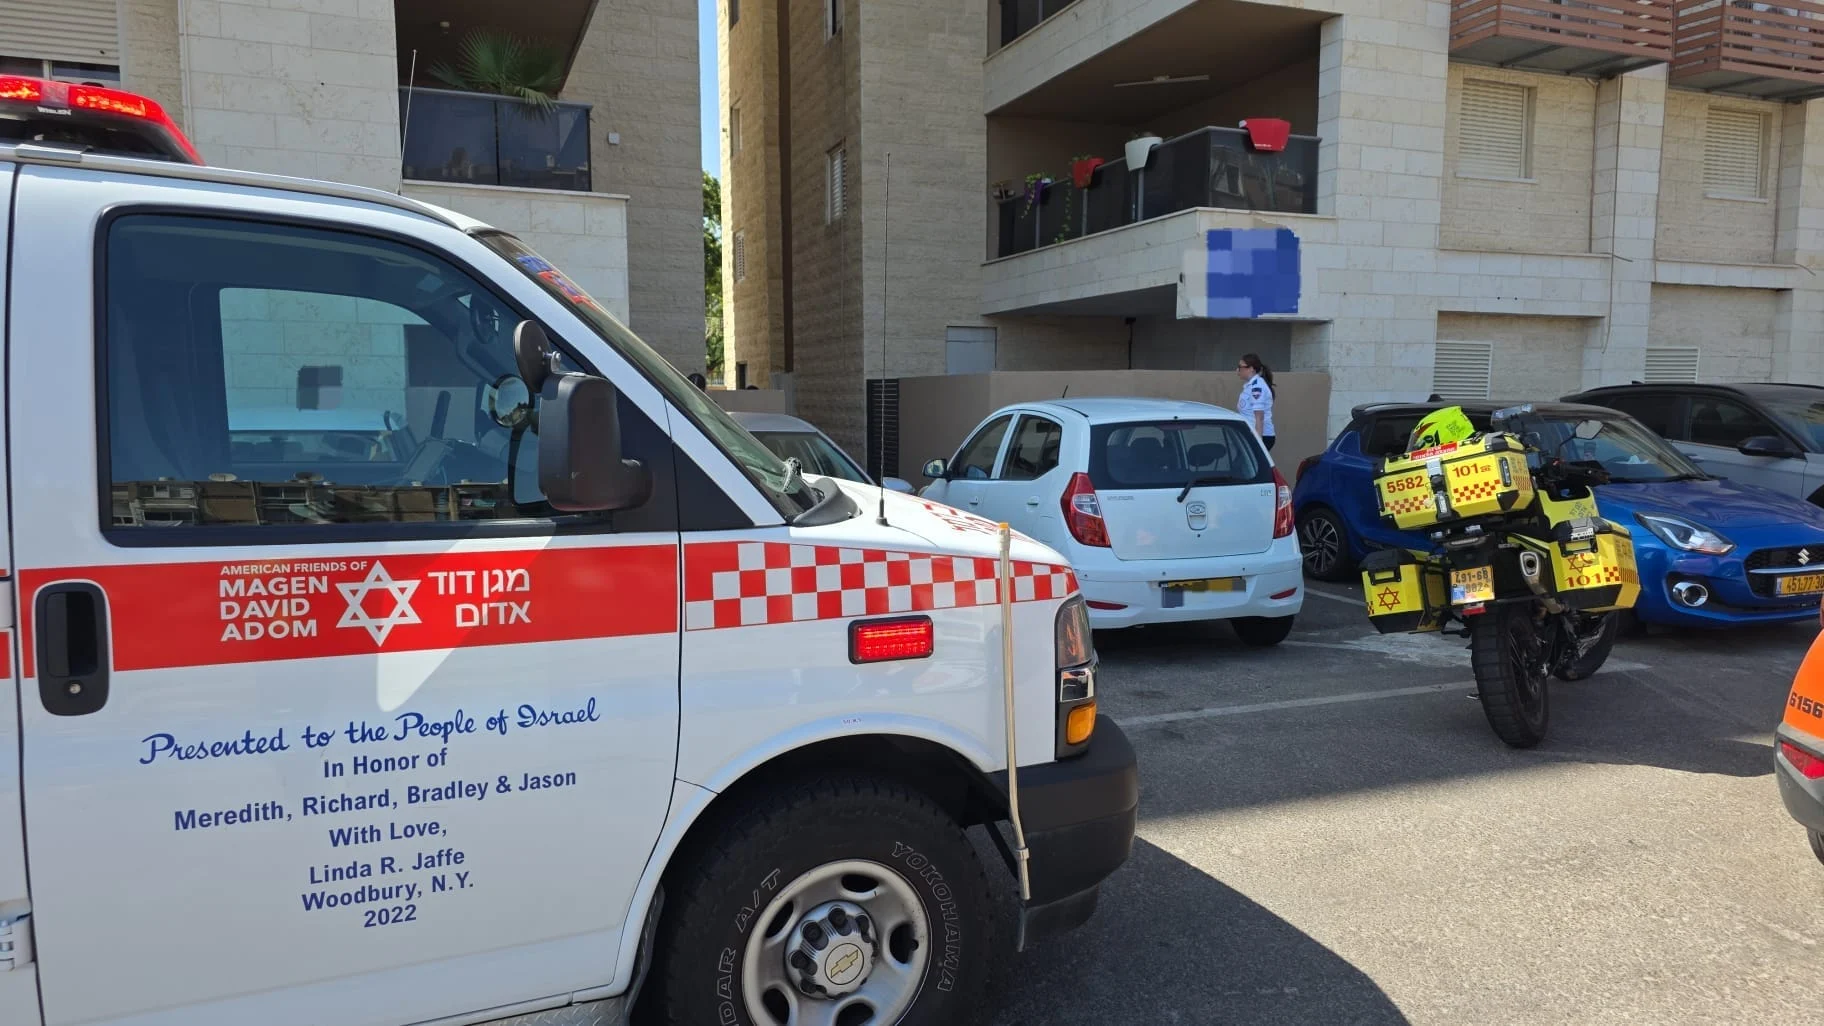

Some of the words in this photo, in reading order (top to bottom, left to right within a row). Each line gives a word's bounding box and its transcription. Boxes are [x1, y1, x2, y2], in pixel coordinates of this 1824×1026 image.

[1386, 475, 1425, 494] 5582
[1452, 463, 1479, 478] 101
[220, 563, 291, 576] AMERICAN
[294, 561, 347, 573] FRIENDS
[350, 560, 368, 571] OF
[1566, 573, 1602, 588] 101
[219, 575, 329, 598] MAGEN
[427, 570, 476, 595] דוד
[482, 568, 531, 599] מגן
[220, 597, 310, 620] DAVID
[455, 600, 532, 628] אדום
[220, 619, 318, 642] ADOM
[1789, 691, 1824, 719] 6156
[139, 727, 290, 765] Presented
[301, 725, 336, 748] to
[344, 721, 389, 744] the
[393, 709, 477, 744] People
[486, 708, 510, 736] of
[516, 696, 601, 728] Israel
[323, 759, 345, 778] In
[353, 754, 420, 775] Honor
[426, 747, 448, 767] of
[174, 801, 293, 831] Meredith,
[302, 789, 398, 816] Richard,
[407, 780, 489, 805] Bradley
[495, 775, 512, 794] &
[518, 771, 577, 791] Jason
[329, 825, 381, 848] With
[389, 820, 447, 841] Love,
[309, 860, 372, 885] Linda
[380, 856, 404, 875] R.
[411, 848, 465, 871] Jaffe
[301, 883, 422, 912] Woodbury,
[431, 871, 474, 893] N.Y.
[735, 868, 781, 933] A/T
[363, 904, 417, 928] 2022
[891, 841, 961, 992] YOKOHAMA
